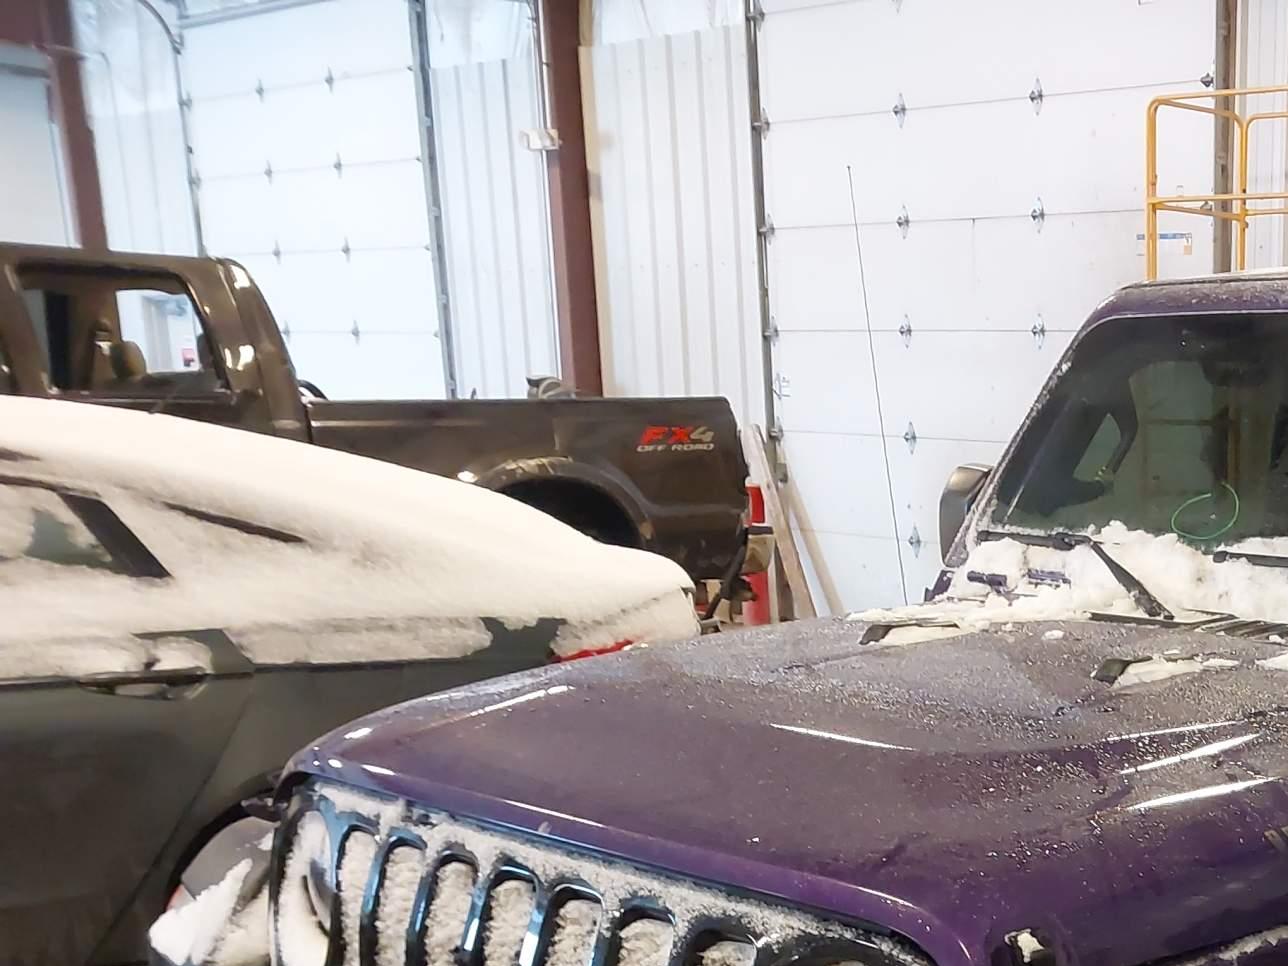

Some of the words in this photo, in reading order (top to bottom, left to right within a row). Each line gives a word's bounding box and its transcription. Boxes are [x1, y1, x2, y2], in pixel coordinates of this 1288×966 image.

[639, 425, 714, 445] FX4
[637, 444, 668, 453] OFF
[671, 443, 714, 452] ROAD
